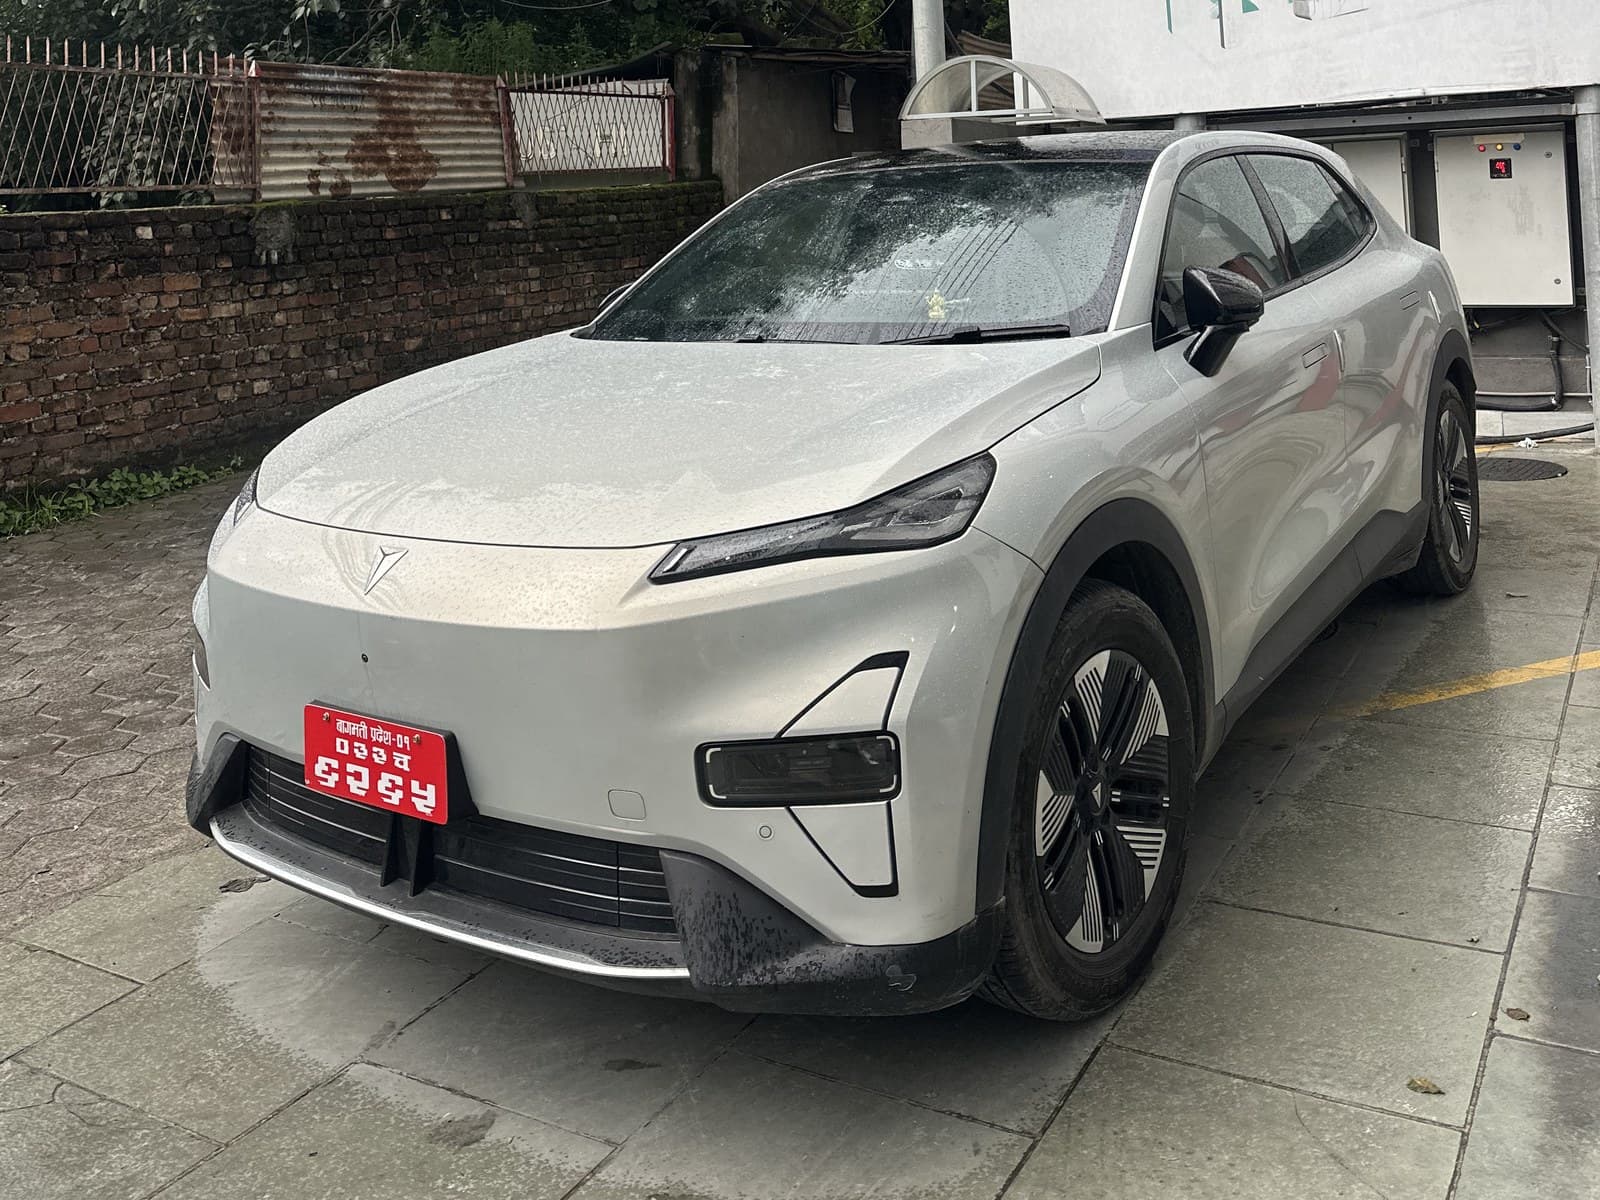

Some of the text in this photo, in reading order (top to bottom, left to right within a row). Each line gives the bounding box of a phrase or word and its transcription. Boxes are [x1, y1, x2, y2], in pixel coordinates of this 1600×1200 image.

[336, 719, 367, 739] बागमती
[393, 751, 412, 772] च
[314, 755, 436, 814] ६२६५
